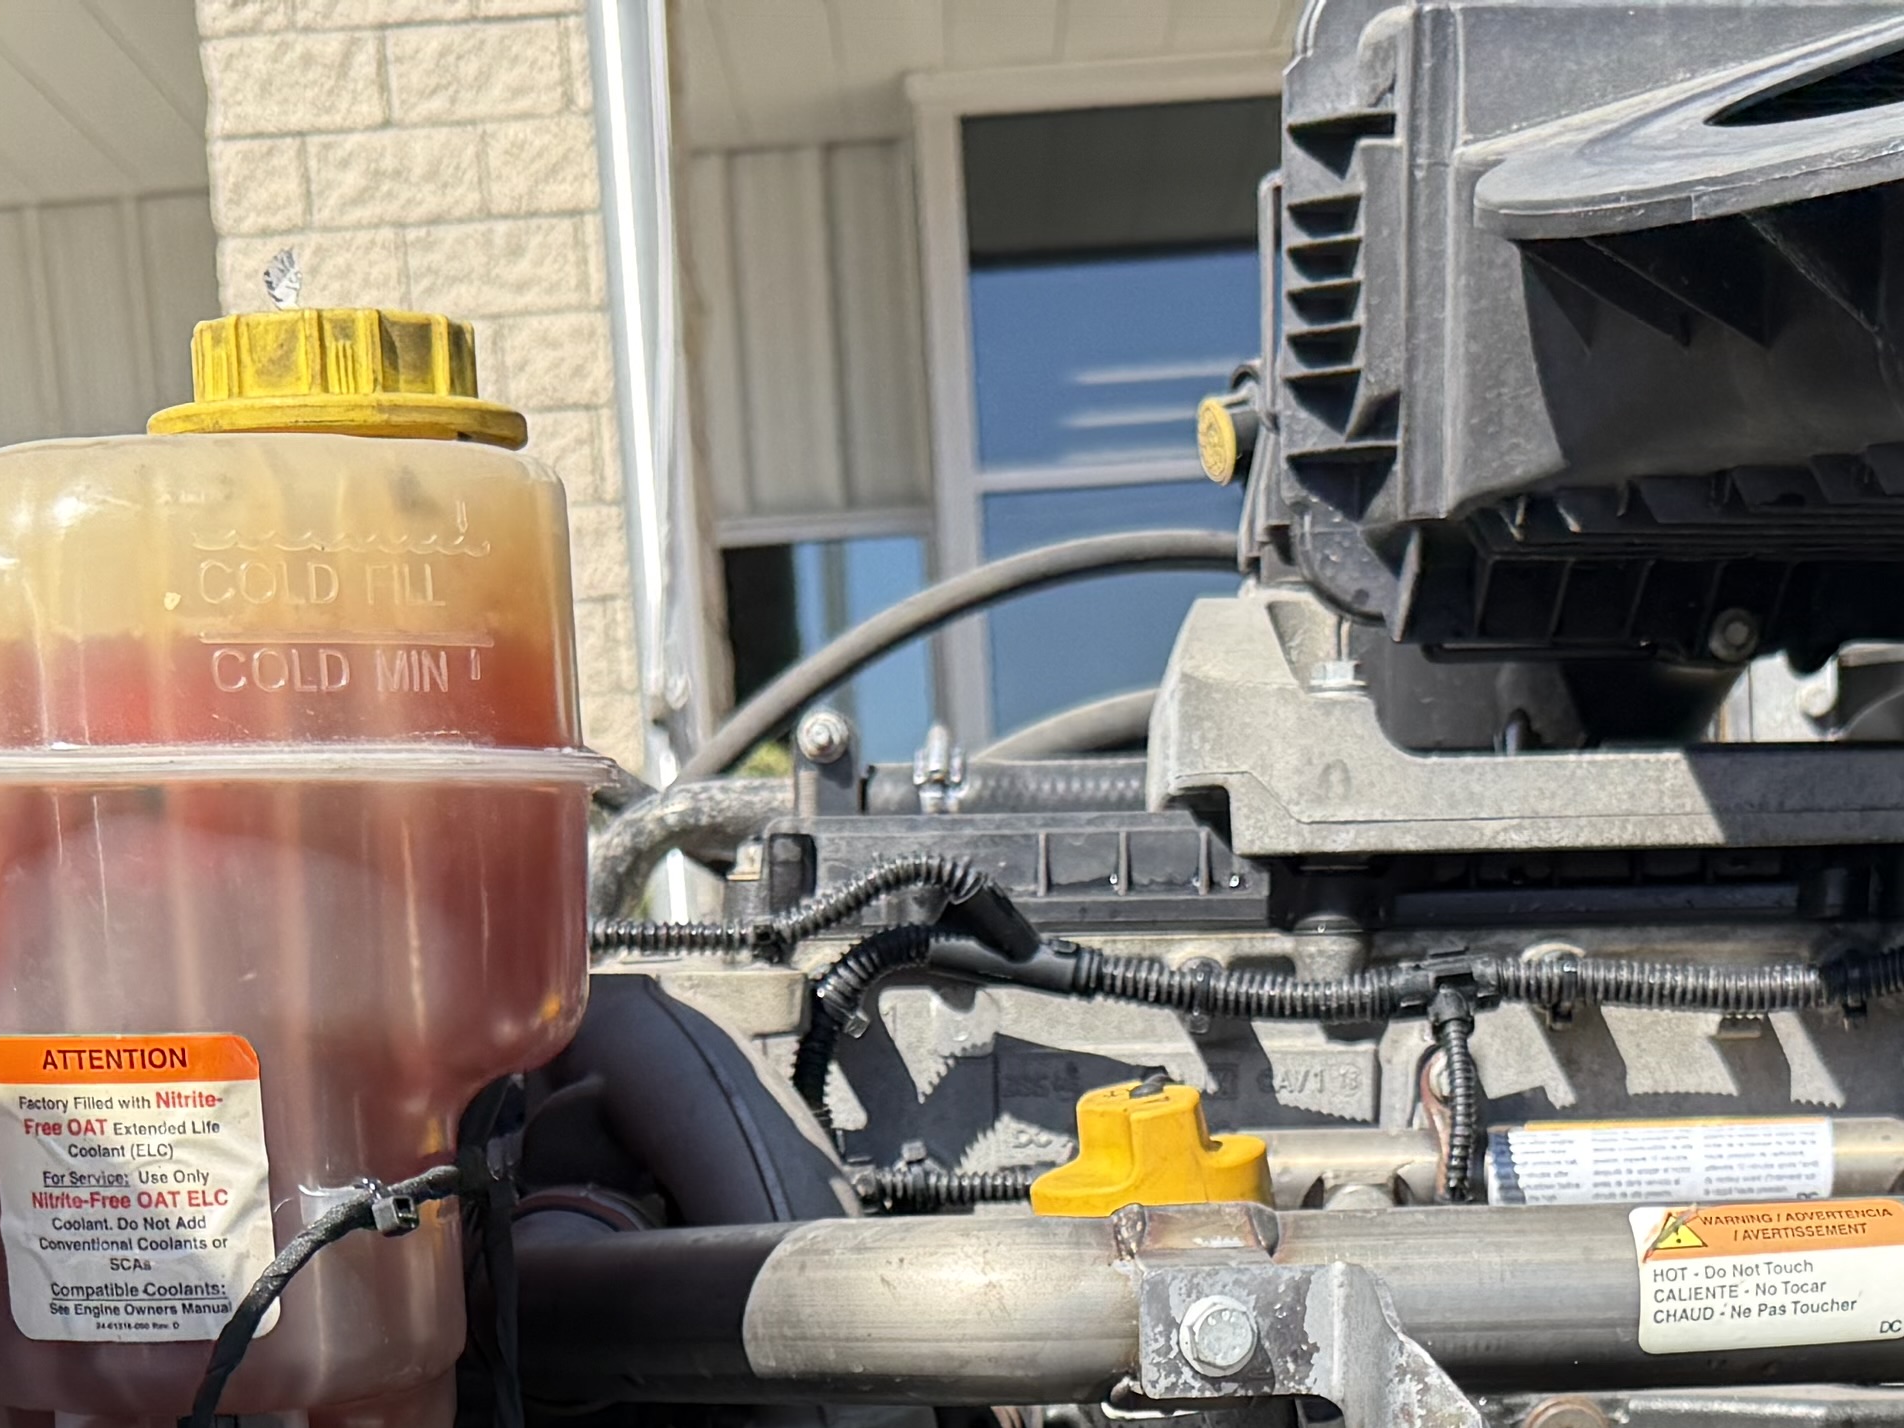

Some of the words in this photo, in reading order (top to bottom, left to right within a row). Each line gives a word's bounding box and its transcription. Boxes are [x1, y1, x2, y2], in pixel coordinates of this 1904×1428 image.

[200, 559, 340, 605] COLD
[365, 562, 447, 607] FILL
[211, 647, 351, 693] COLD
[375, 649, 450, 693] MIN
[42, 1048, 188, 1070] ATTENTION
[19, 1096, 68, 1112] Factory
[74, 1097, 113, 1110] Filled
[119, 1097, 151, 1109] with
[155, 1091, 223, 1109] Nitrite-
[23, 1119, 62, 1136] Free
[67, 1119, 107, 1135] OAT
[113, 1121, 186, 1136] Extended
[191, 1121, 220, 1134] Life
[68, 1144, 126, 1158] Coolant
[130, 1142, 174, 1159] (ELC)
[43, 1171, 65, 1184] For
[69, 1171, 129, 1185] Service:
[139, 1170, 168, 1184] Use
[174, 1170, 209, 1186] Only
[32, 1191, 131, 1209] Nitrite-Free
[137, 1191, 180, 1208] OAT
[187, 1189, 228, 1207] ELC
[52, 1217, 113, 1231] Coolant.
[117, 1217, 139, 1231] Do
[144, 1217, 170, 1230] Not
[176, 1216, 206, 1230] Add
[1700, 1211, 1773, 1229] WARNING
[1786, 1207, 1893, 1223] ADVERTENCIA
[1742, 1222, 1868, 1242] AVERTISSEMENT
[39, 1237, 133, 1251] Conventional
[137, 1237, 207, 1251] Coolants
[212, 1237, 228, 1249] or
[110, 1257, 151, 1271] SCAs
[1653, 1266, 1688, 1284] HOT
[1704, 1264, 1726, 1280] Do
[1731, 1263, 1761, 1279] Not
[1764, 1258, 1814, 1277] Touch
[51, 1282, 139, 1298] Compatible
[142, 1282, 226, 1297] Coolants:
[1653, 1283, 1740, 1304] CALIENTE
[1755, 1281, 1776, 1297] No
[1782, 1278, 1828, 1295] Tocar
[49, 1303, 70, 1315] See
[74, 1303, 120, 1317] Engine
[124, 1303, 178, 1316] Owners
[182, 1301, 232, 1315] Manual
[1653, 1306, 1715, 1325] CHAUD
[1730, 1304, 1752, 1319] Ne
[1757, 1303, 1786, 1319] Pas
[1791, 1298, 1858, 1315] Toucher
[1879, 1319, 1902, 1334] DC
